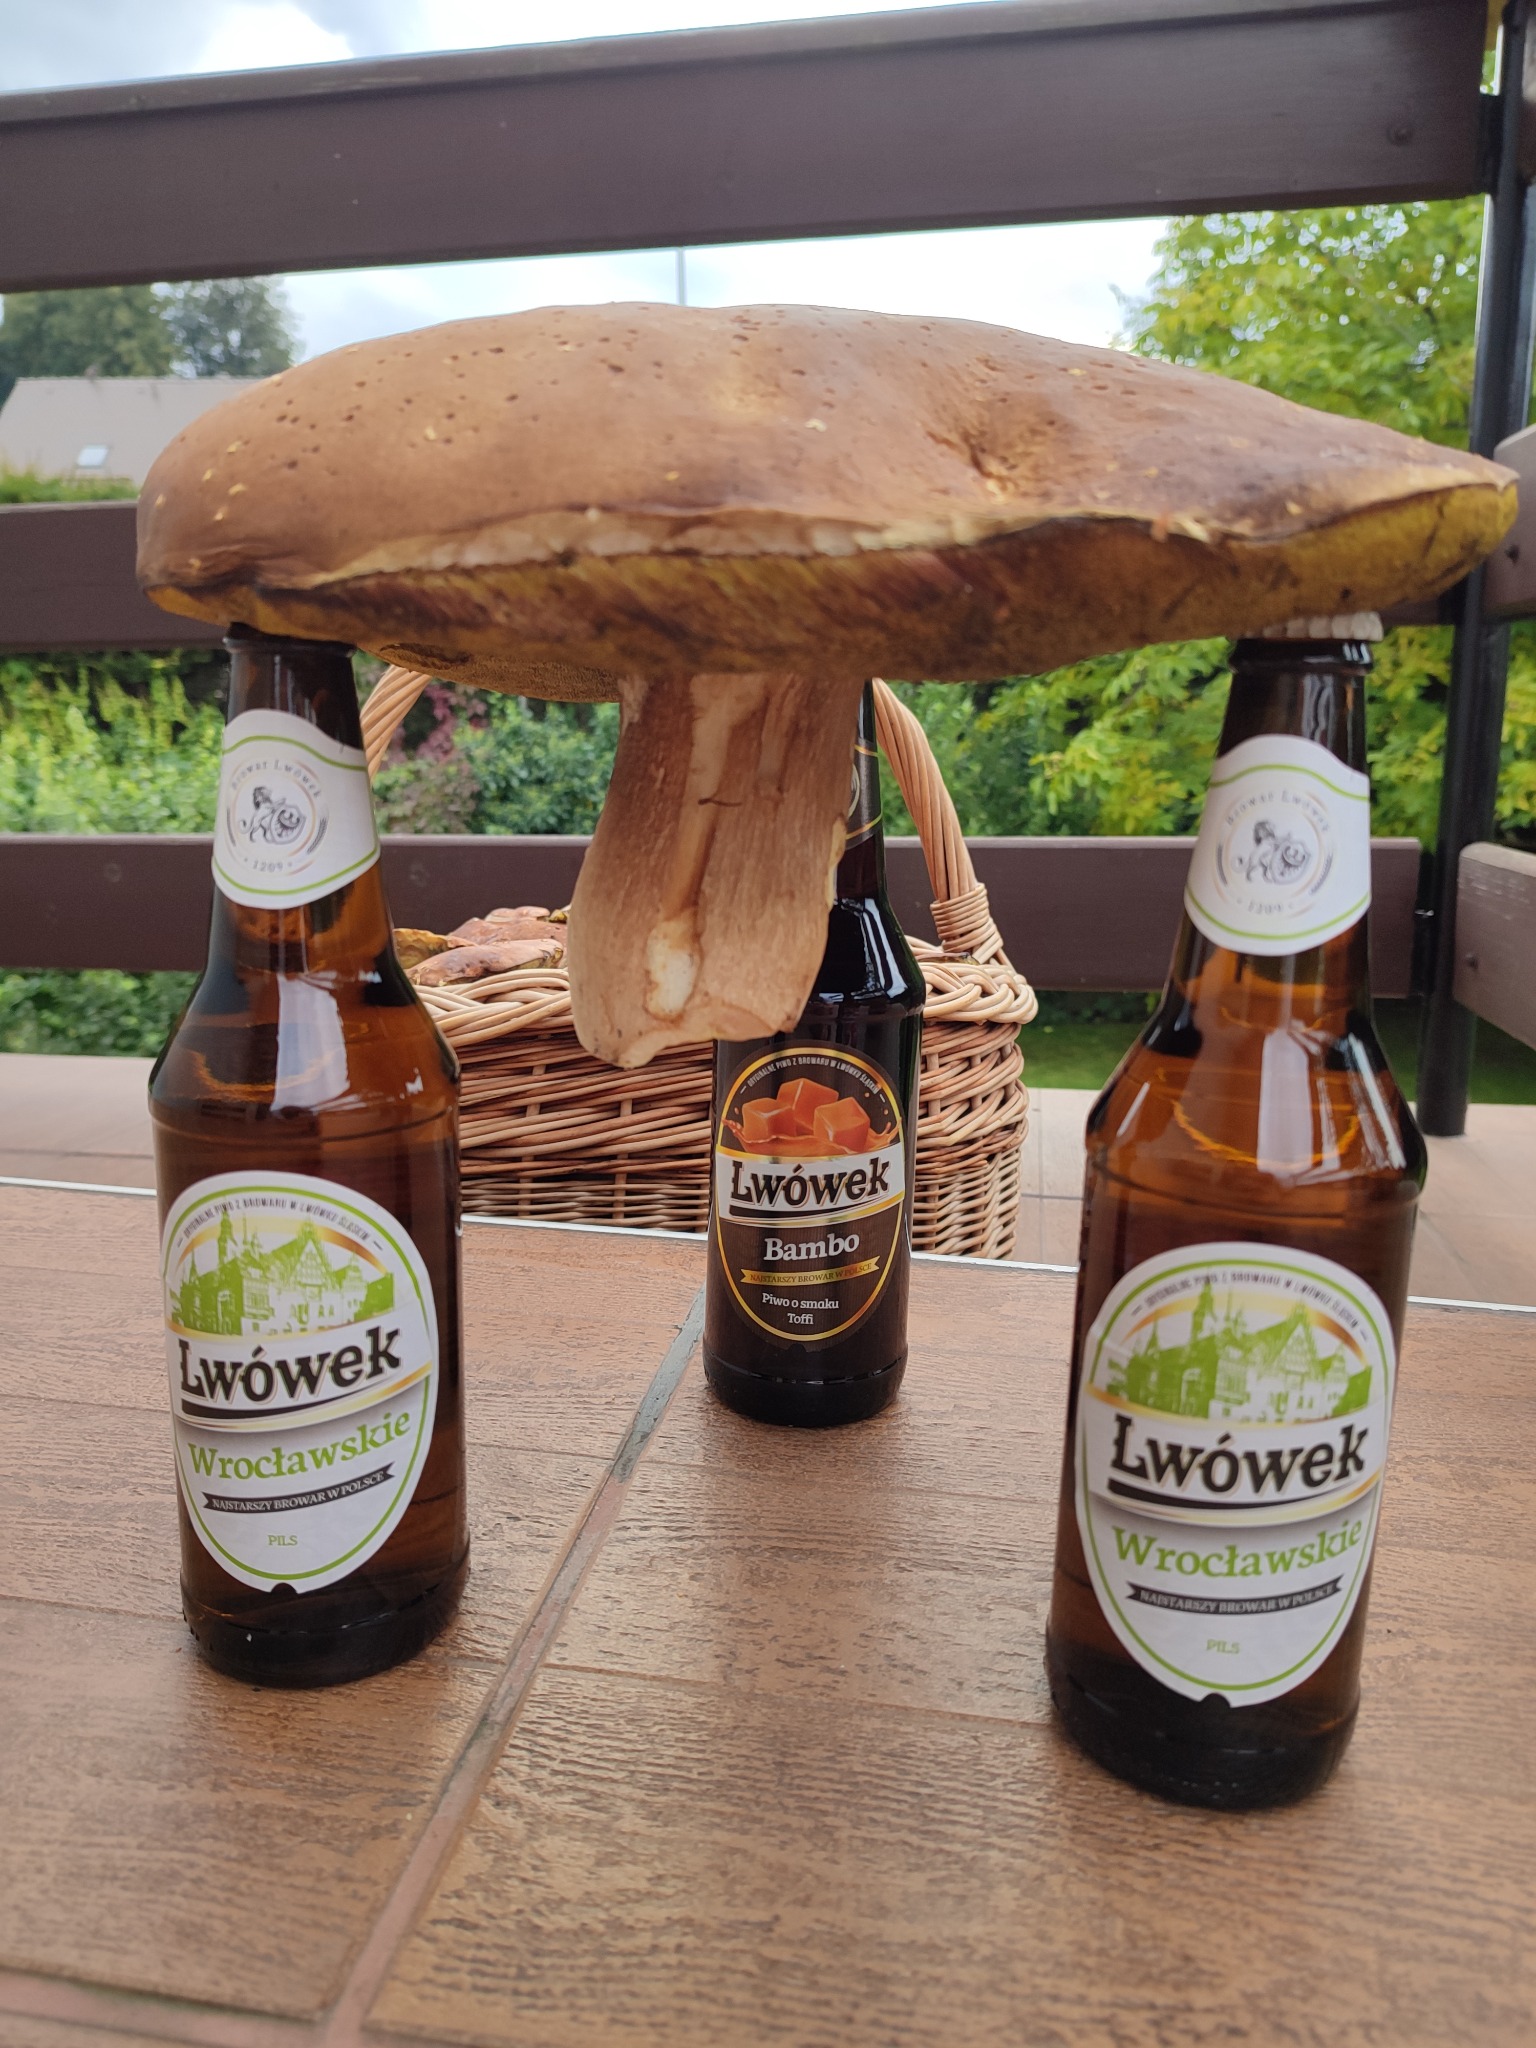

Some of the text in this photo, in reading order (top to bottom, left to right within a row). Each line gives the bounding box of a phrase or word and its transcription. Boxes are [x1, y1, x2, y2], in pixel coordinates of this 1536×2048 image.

[730, 1157, 890, 1208] Lwówek
[763, 1233, 860, 1261] Bambo
[749, 1262, 873, 1283] NAJSTARSZY BROWAR W POLSCE
[762, 1292, 840, 1309] Piwo o smaku
[787, 1312, 814, 1325] Toffi
[178, 1326, 402, 1404] Lwówek
[188, 1411, 412, 1480] Wrocławskie
[1109, 1413, 1371, 1497] Lwówek
[211, 1471, 385, 1511] NAJSTARSZY BROWAR W POLSCE
[267, 1534, 299, 1547] PILS
[1111, 1519, 1362, 1578] Wrocławskie
[1206, 1639, 1241, 1655] PILS
